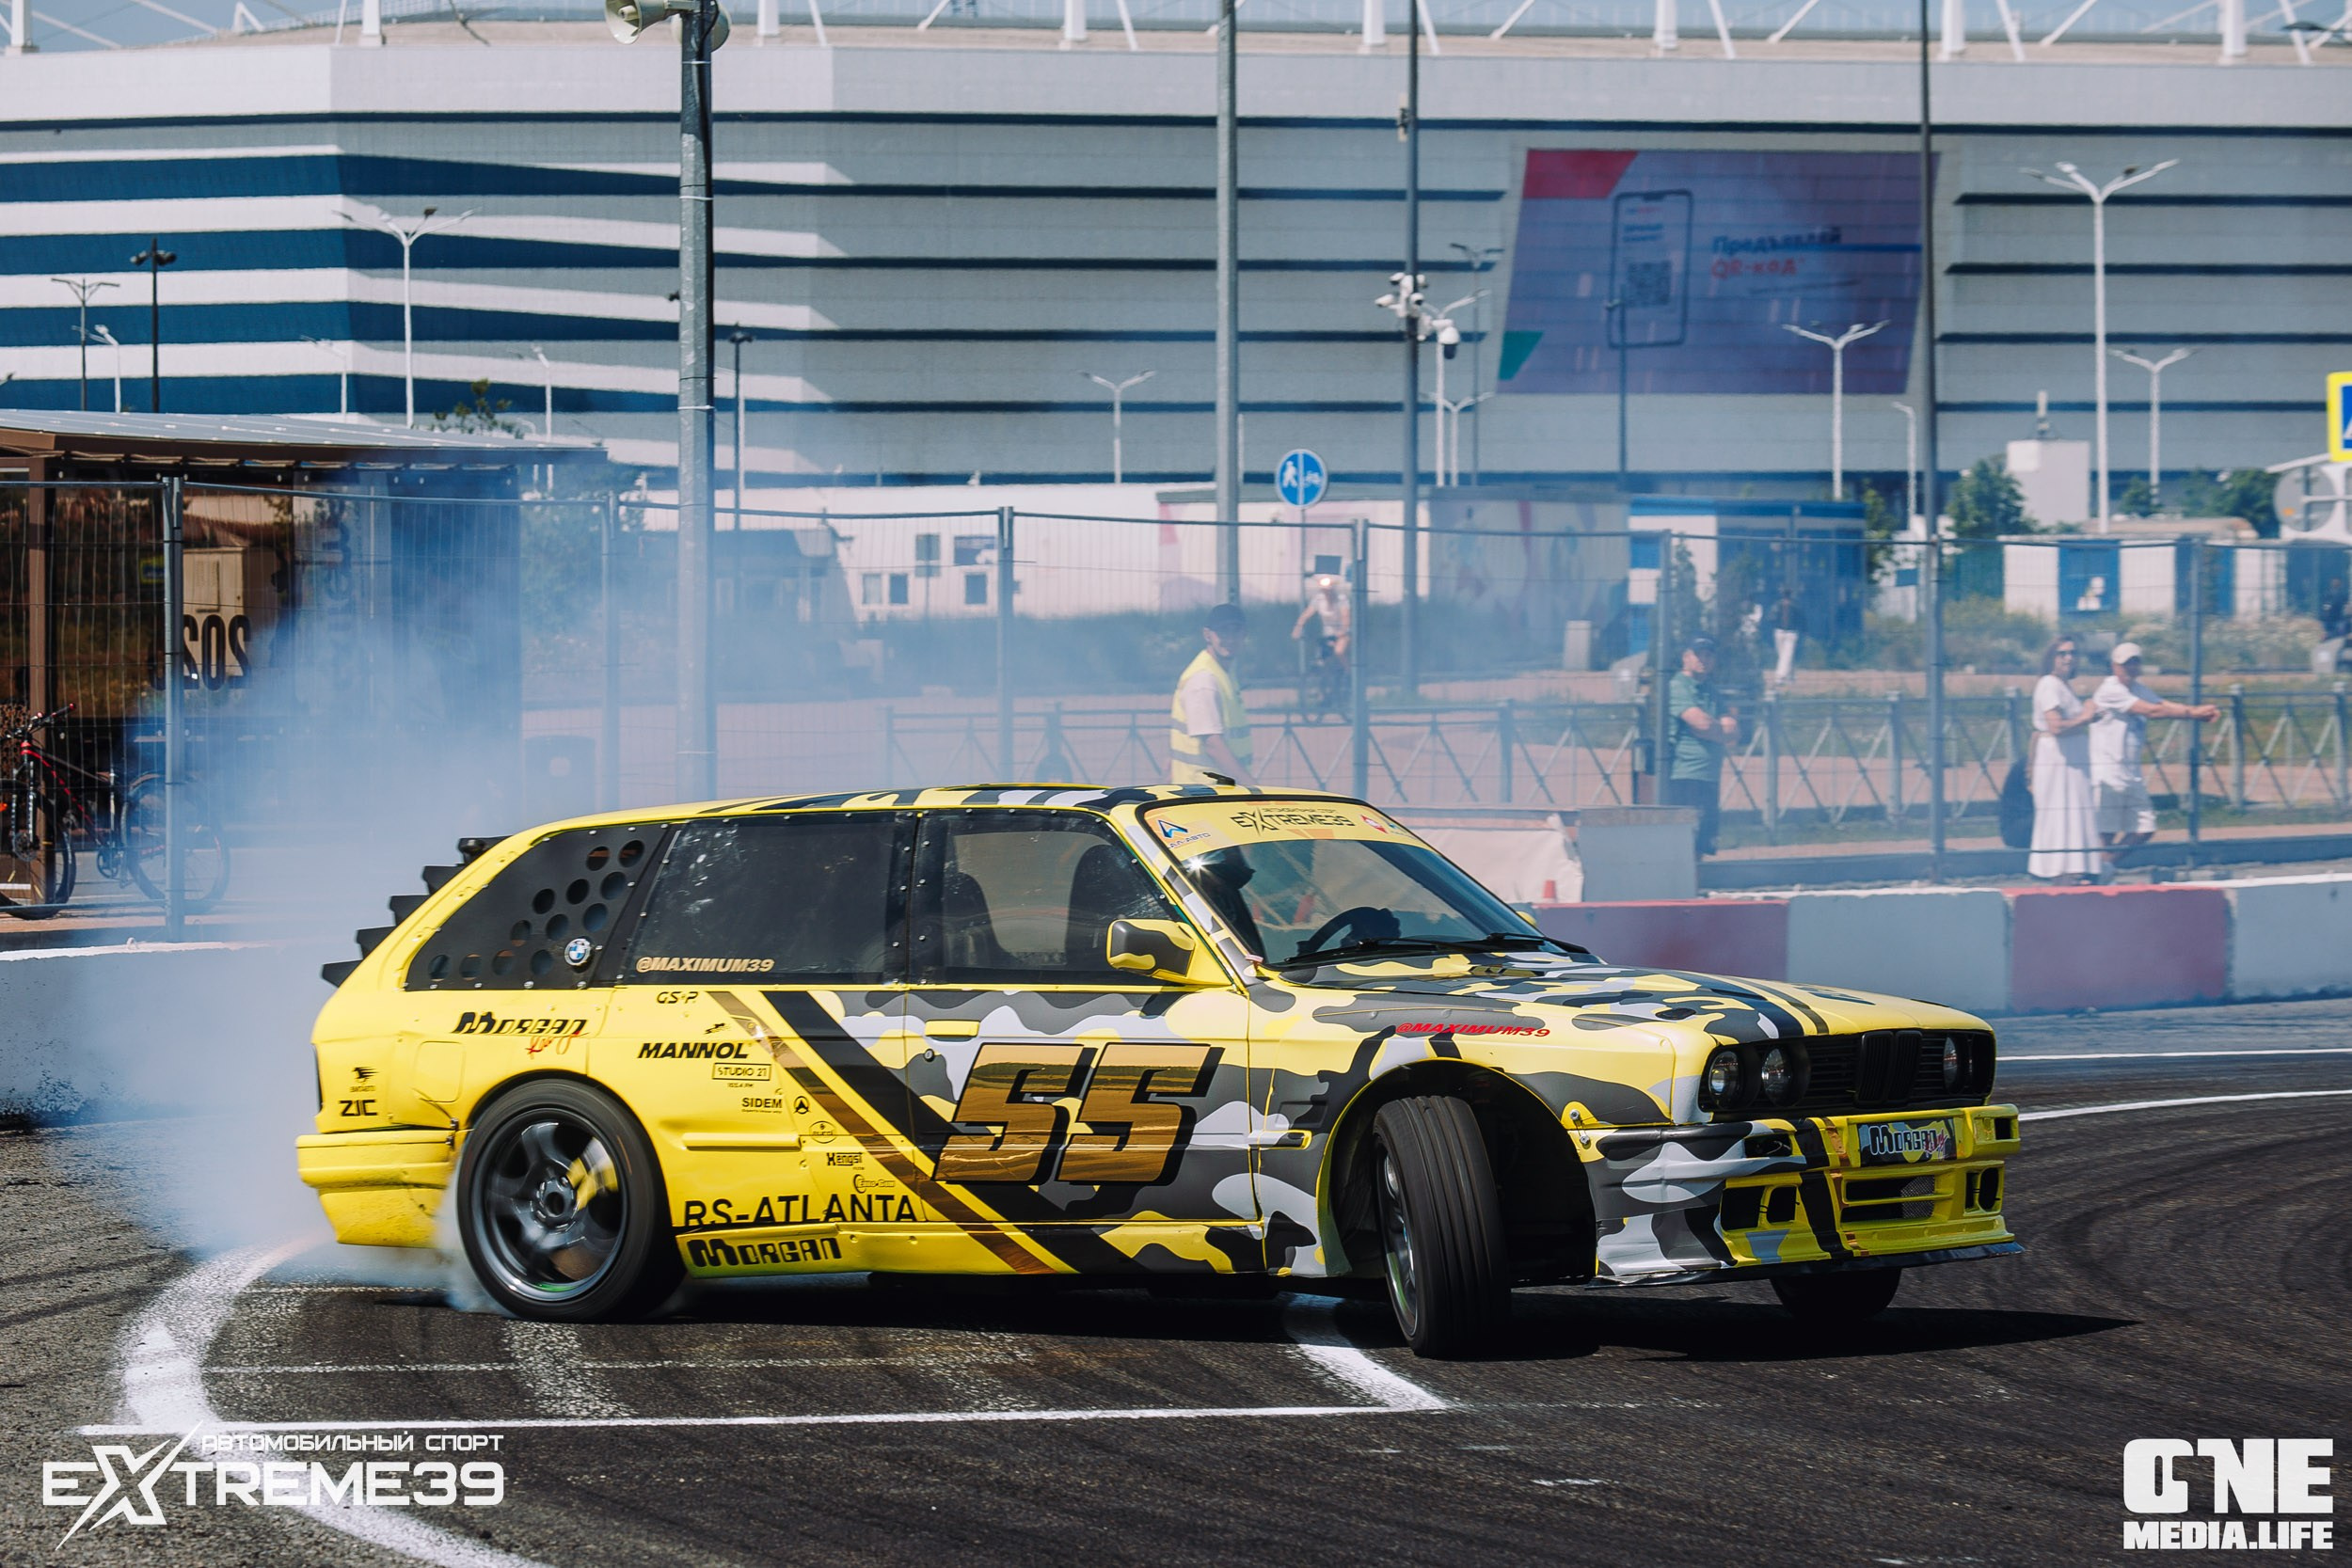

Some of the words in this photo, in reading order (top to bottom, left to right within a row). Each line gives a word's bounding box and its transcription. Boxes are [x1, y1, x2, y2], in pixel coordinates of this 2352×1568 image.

[636, 957, 775, 973] @MAXIMUM39
[1396, 1023, 1550, 1037] @MAXIMUM39
[638, 1042, 749, 1059] MANNOL
[718, 1067, 753, 1077] STUDIO
[741, 1097, 783, 1109] SIDEM
[931, 1042, 1225, 1186] 55
